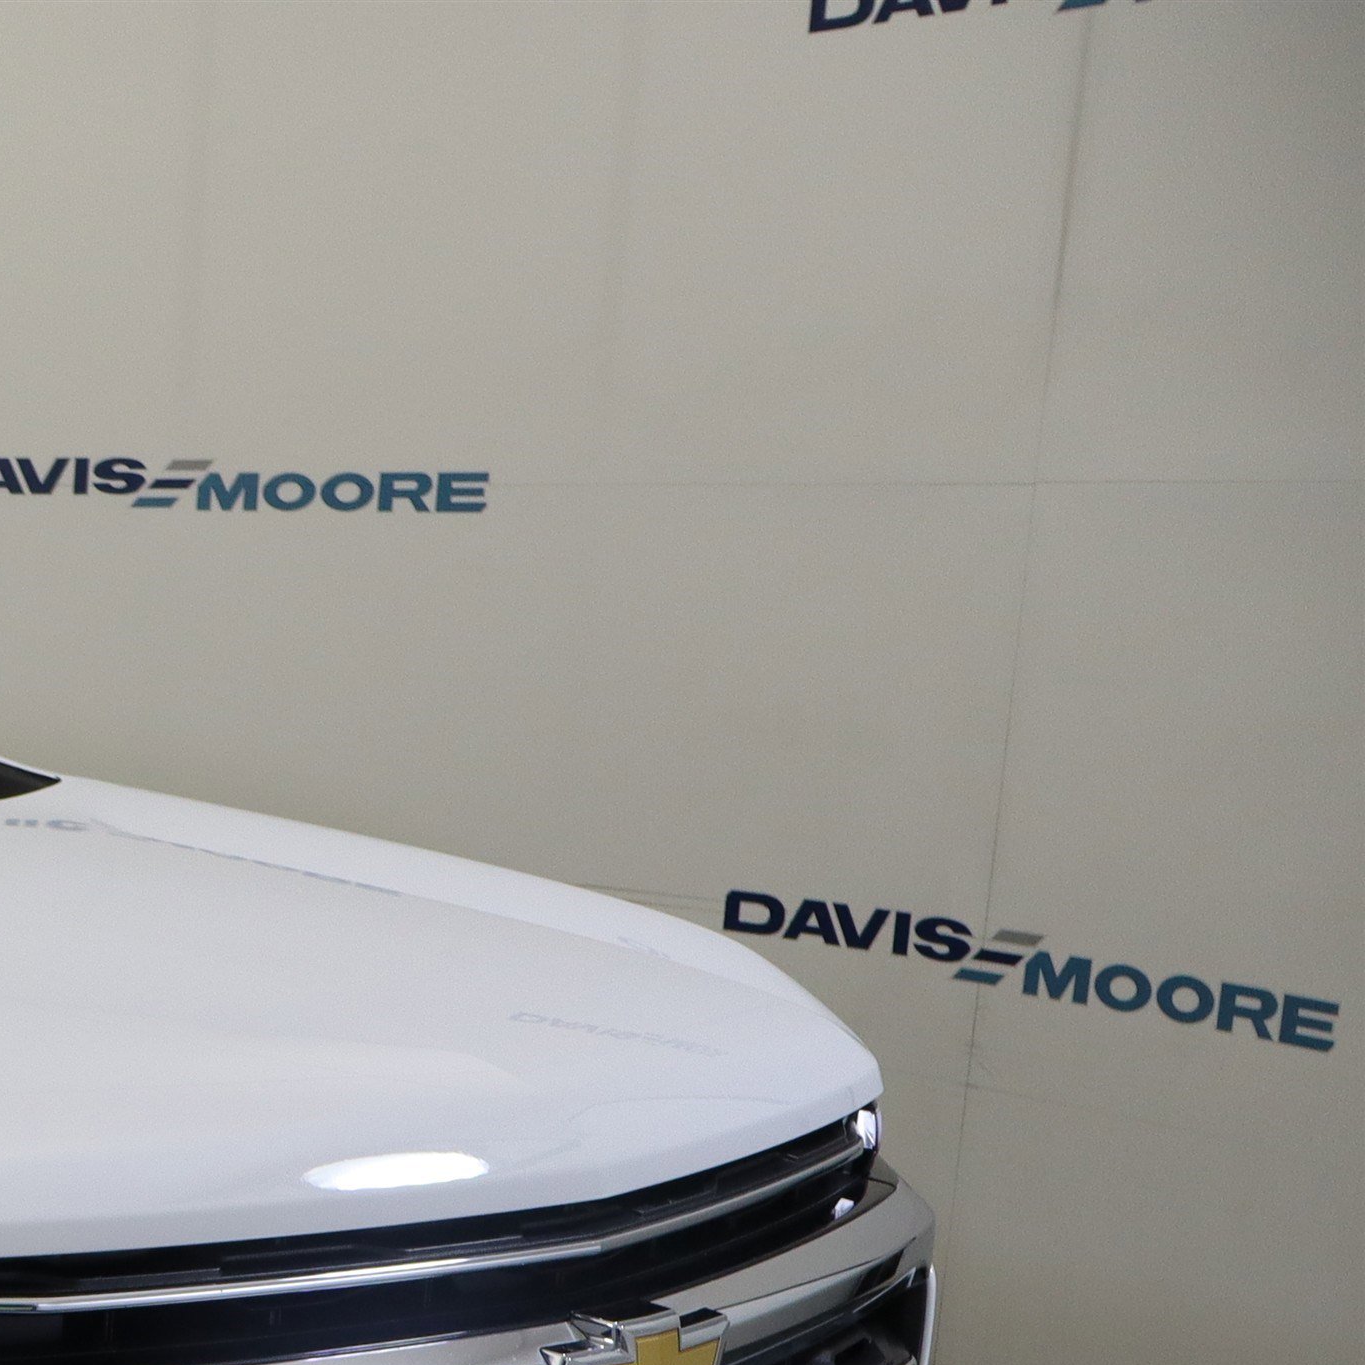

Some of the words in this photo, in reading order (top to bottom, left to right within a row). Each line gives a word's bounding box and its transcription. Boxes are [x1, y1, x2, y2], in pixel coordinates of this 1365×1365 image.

[195, 471, 490, 514] MOORE
[722, 889, 973, 964] DAVIS
[1021, 950, 1340, 1054] MOORE
